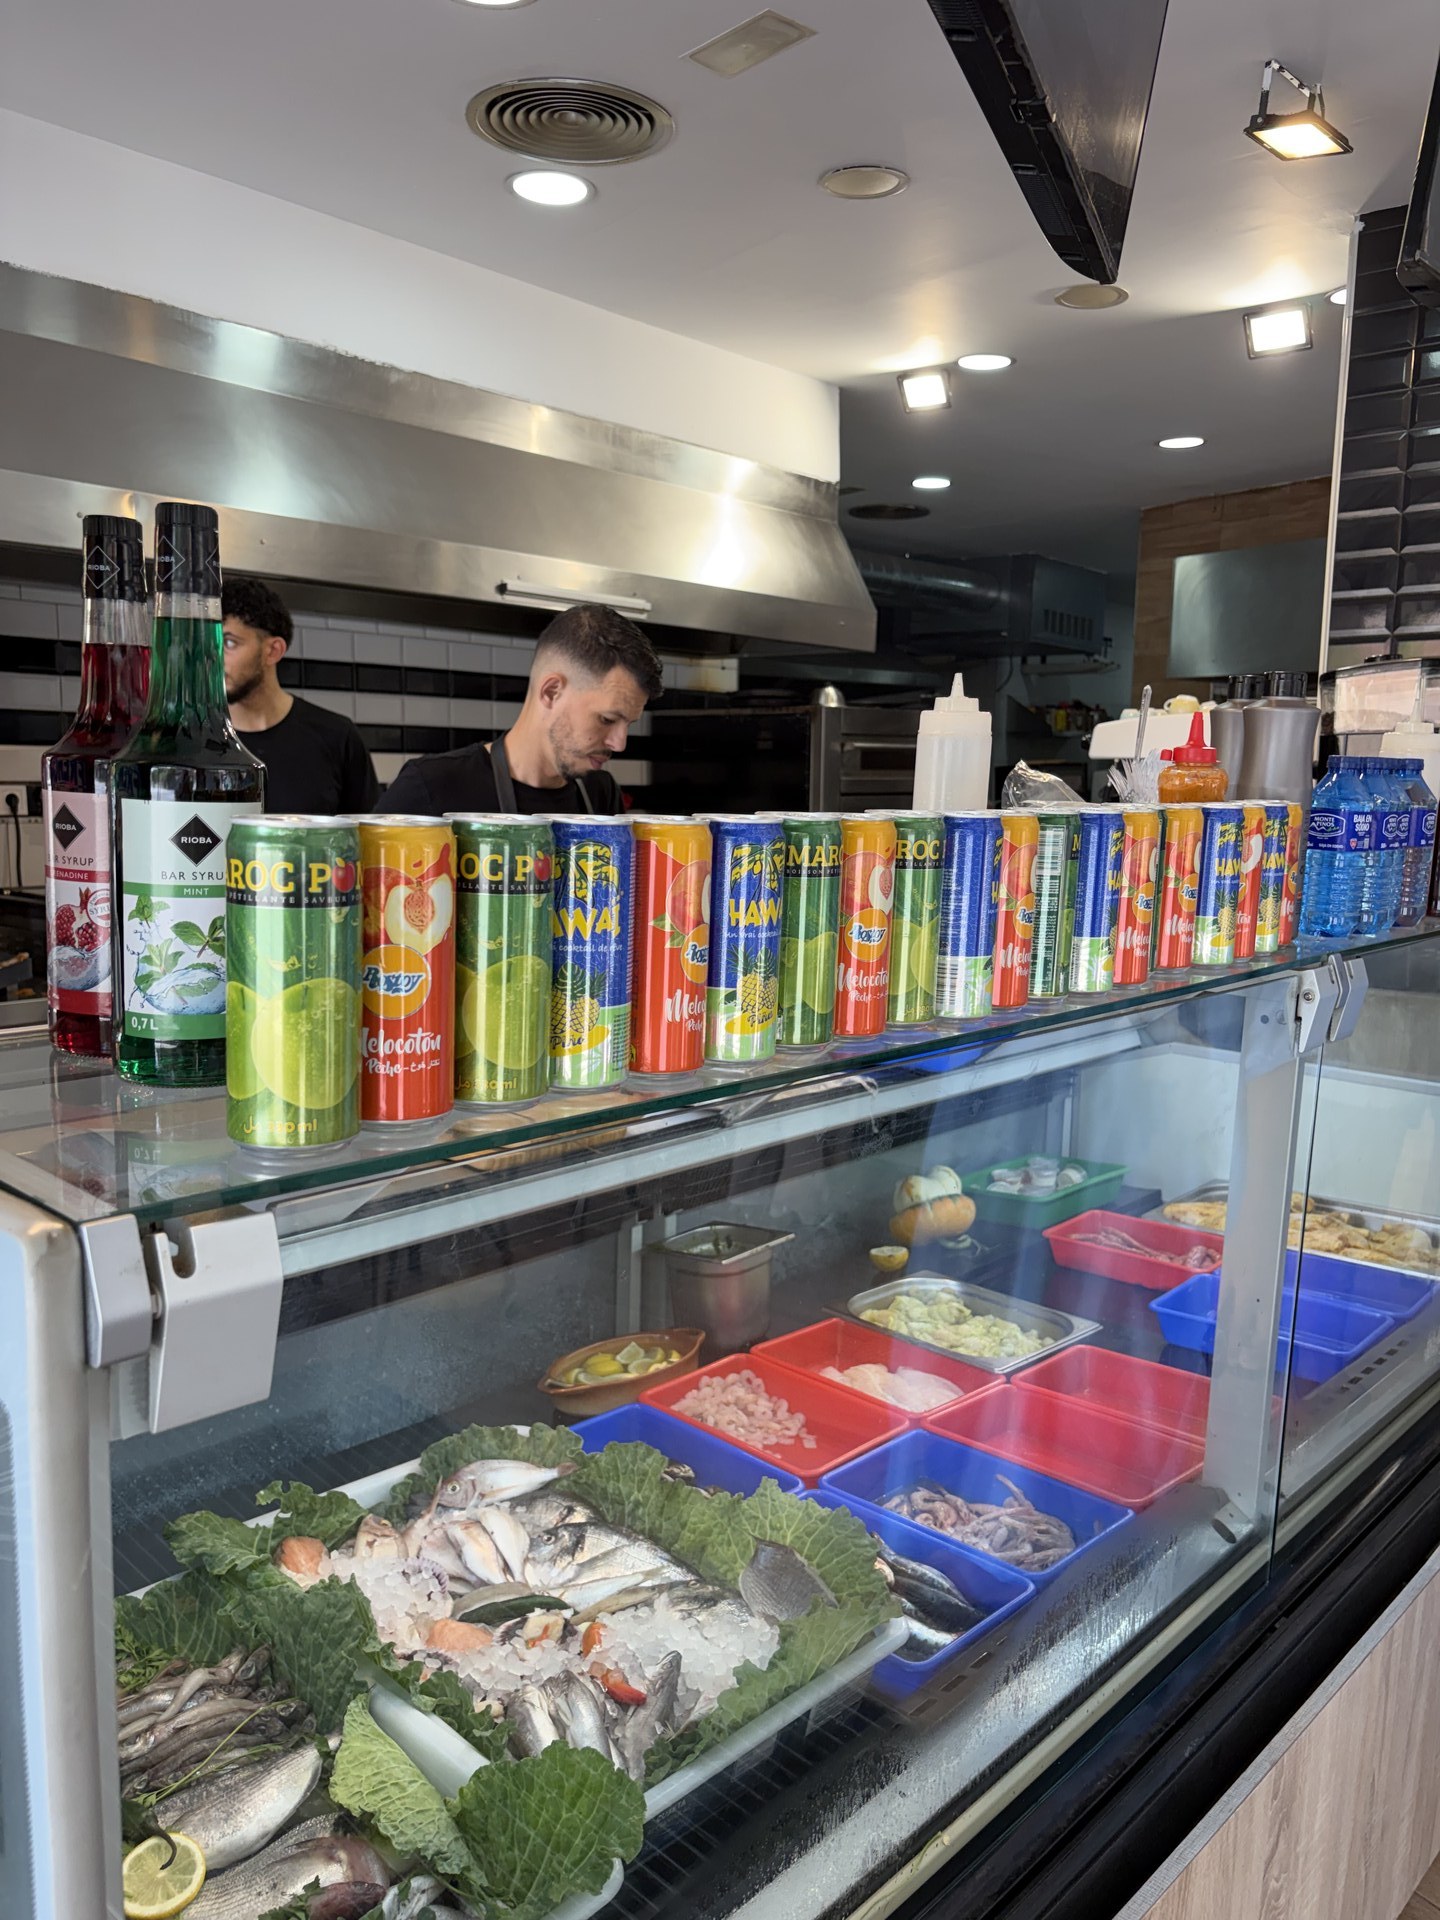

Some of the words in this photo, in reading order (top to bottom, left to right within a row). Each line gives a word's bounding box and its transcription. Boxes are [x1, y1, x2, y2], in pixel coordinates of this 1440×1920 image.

[87, 564, 111, 572] RIOBA
[55, 822, 77, 832] RIOBA
[180, 836, 213, 845] RIOBA
[62, 855, 94, 866] SYRUP
[53, 870, 89, 880] ENADINE
[161, 871, 187, 881] BAR
[192, 871, 225, 881] SYRU
[183, 887, 210, 896] MINT
